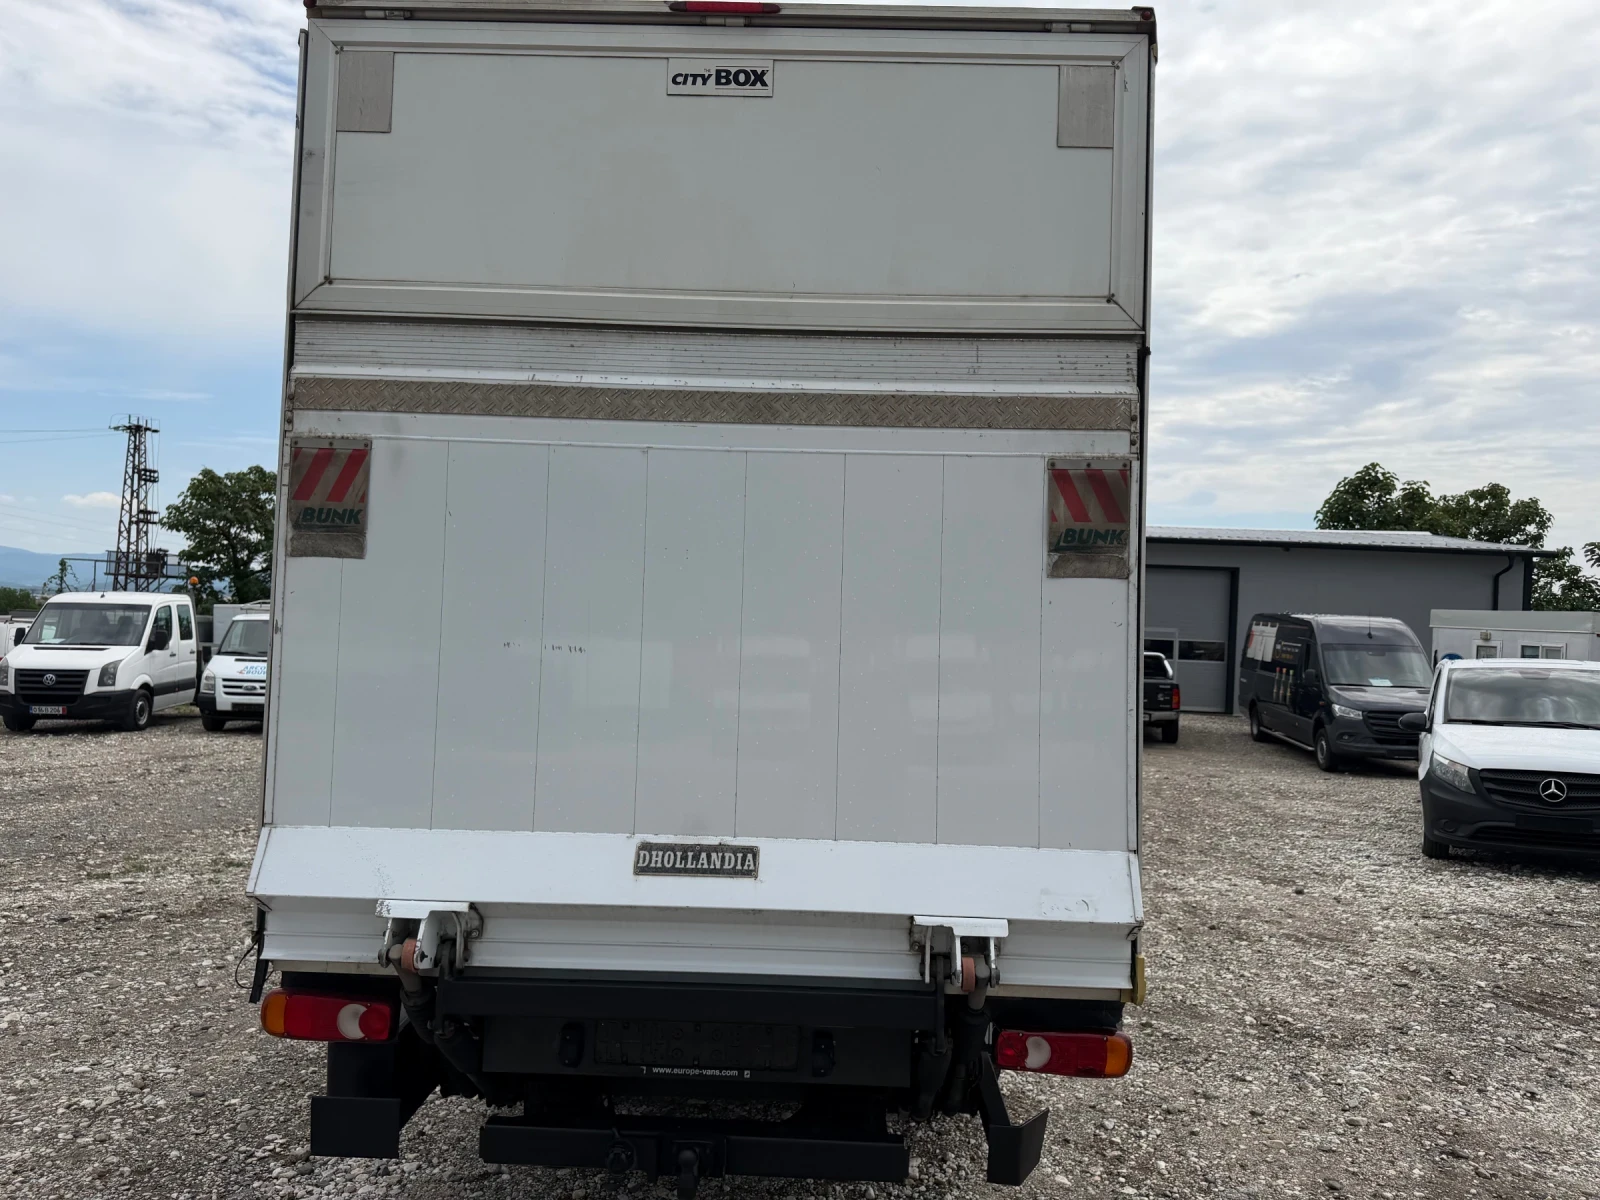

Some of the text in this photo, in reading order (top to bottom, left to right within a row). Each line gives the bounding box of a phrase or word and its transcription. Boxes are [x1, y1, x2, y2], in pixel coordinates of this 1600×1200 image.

[671, 68, 769, 87] CITY BOX
[300, 507, 363, 525] BUNK
[1061, 528, 1126, 545] BUNK
[637, 850, 755, 870] DHOLLANDIA
[652, 1067, 738, 1077] www.europe-vans.com
